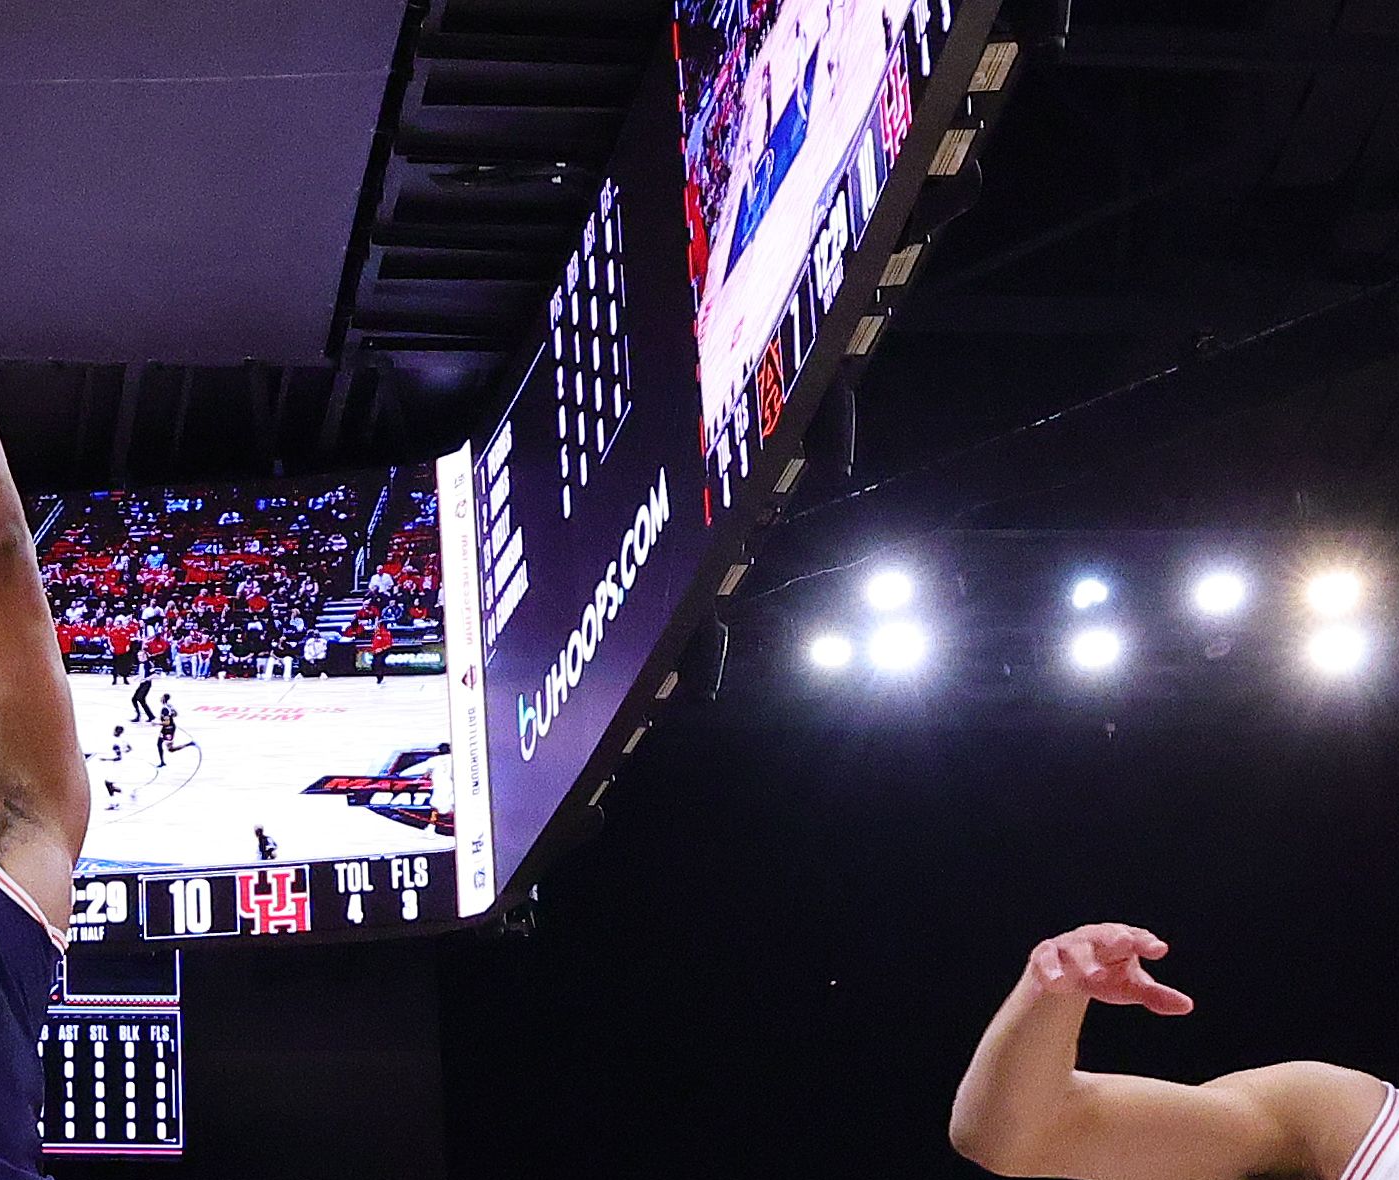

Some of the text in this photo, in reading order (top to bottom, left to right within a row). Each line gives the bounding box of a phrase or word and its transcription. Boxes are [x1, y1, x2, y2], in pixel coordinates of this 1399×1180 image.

[335, 857, 430, 894] TOL FLS
[69, 880, 128, 925] :29
[168, 878, 213, 935] 10
[346, 889, 419, 925] 4 3
[59, 1025, 170, 1041] AST STL BLK FLS
